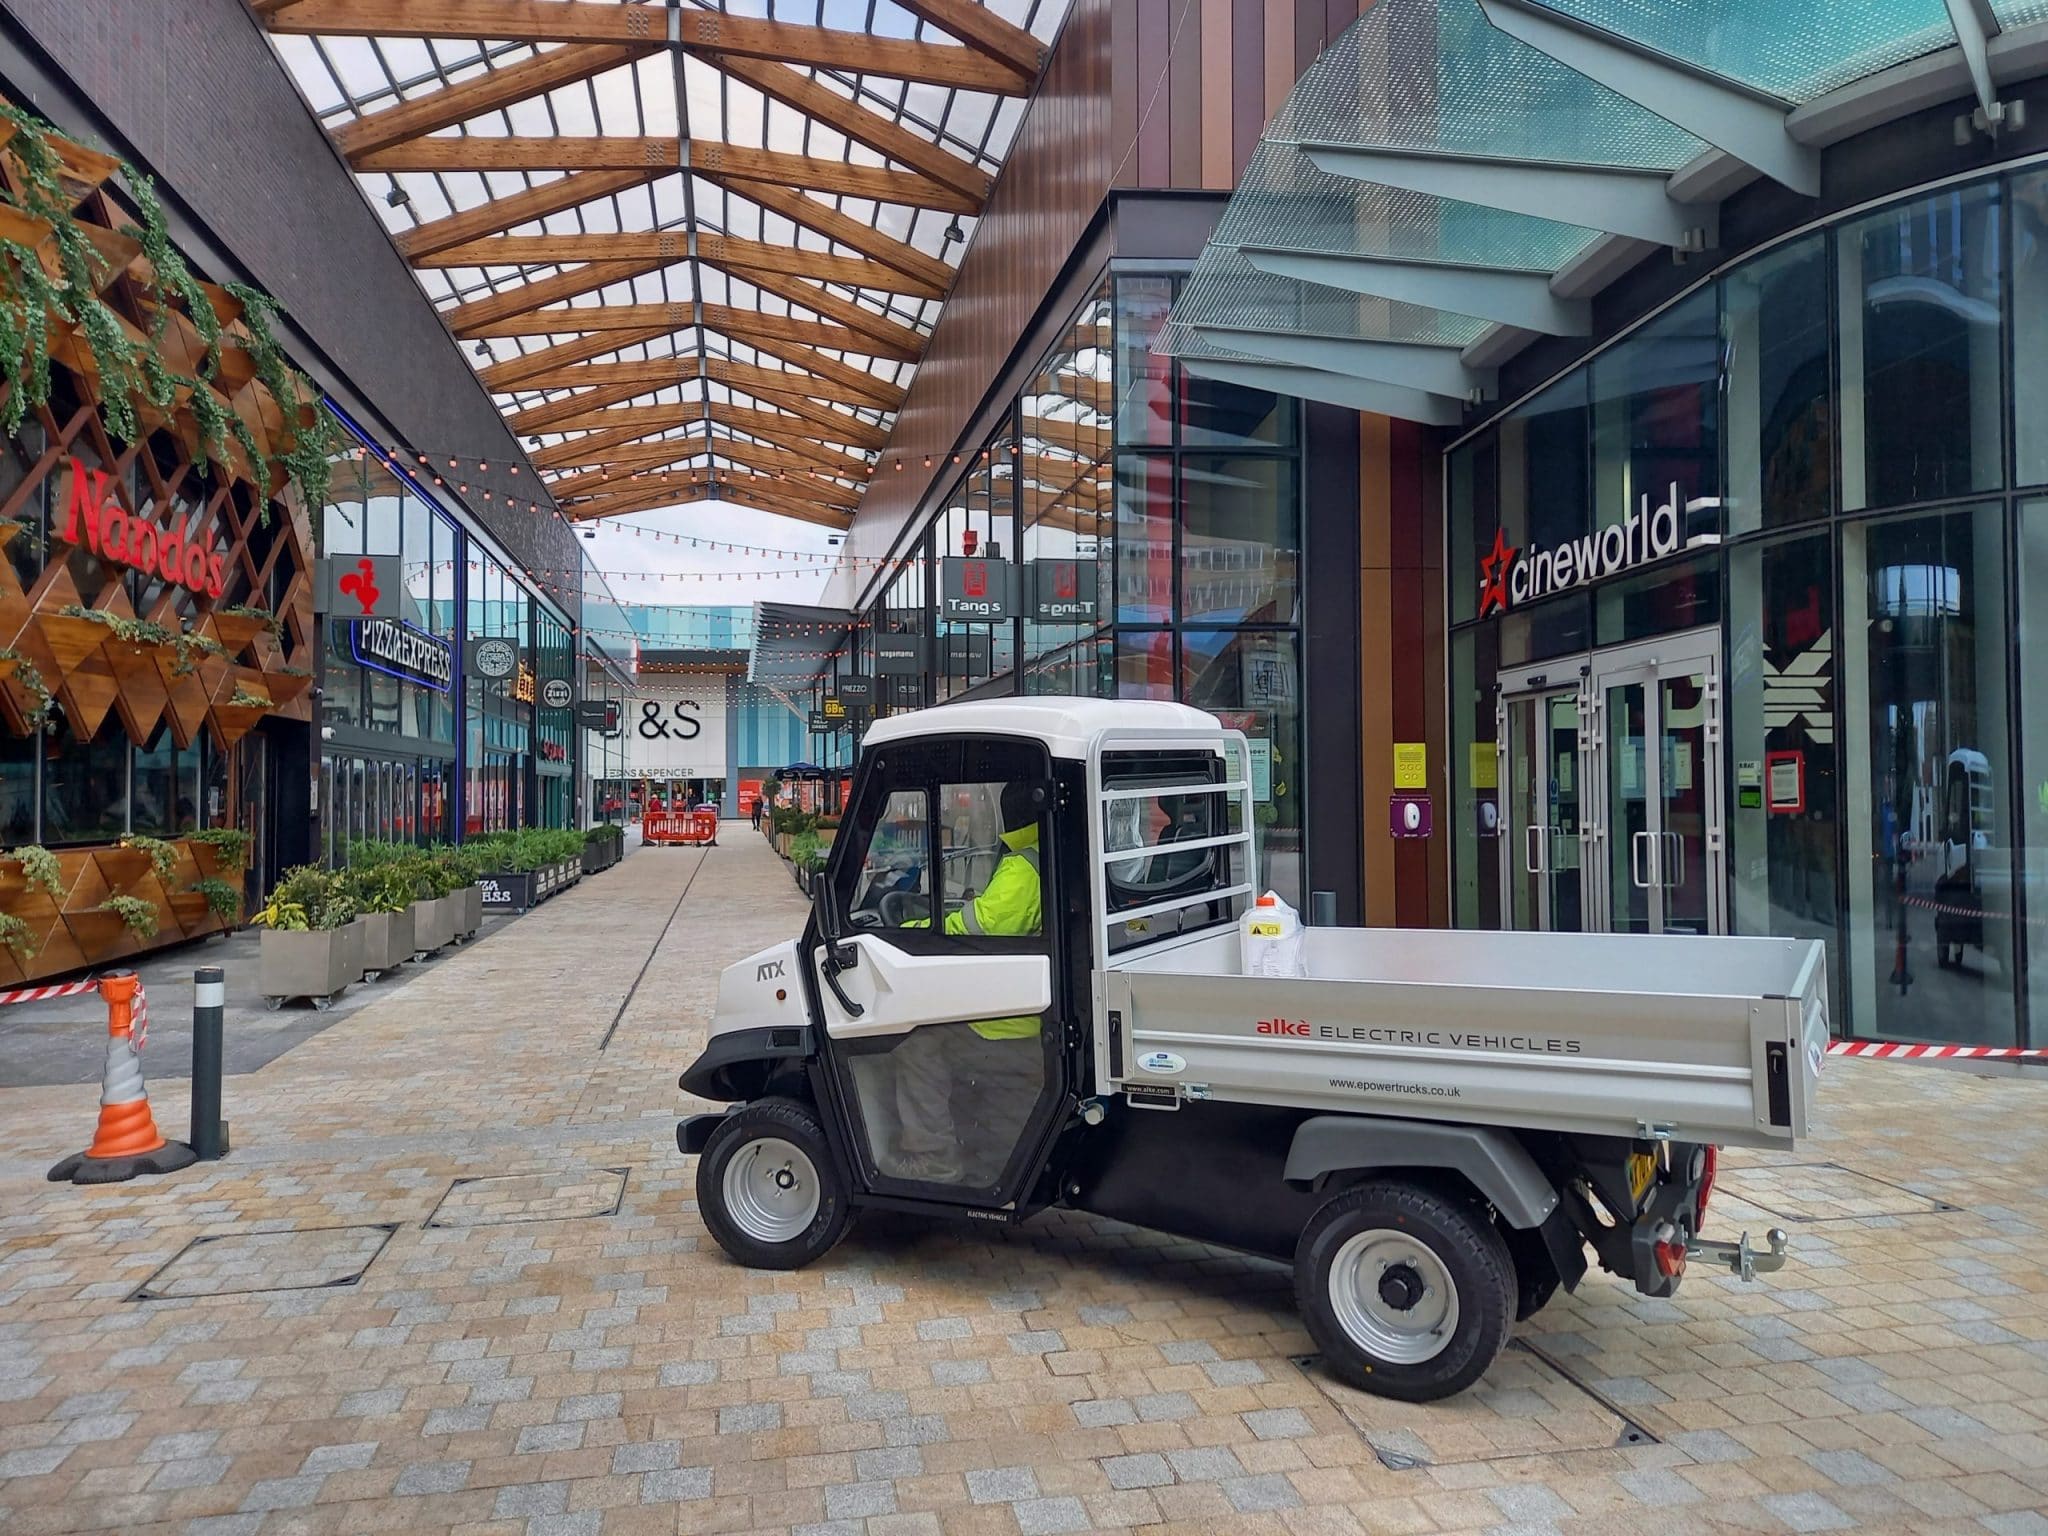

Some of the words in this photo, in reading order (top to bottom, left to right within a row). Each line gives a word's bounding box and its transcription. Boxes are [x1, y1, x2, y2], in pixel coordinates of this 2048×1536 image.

[63, 456, 225, 599] Nando's
[1511, 481, 1677, 601] cineworld
[361, 619, 450, 682] PIZZAEXPRESS
[639, 700, 700, 739] &S
[647, 768, 694, 777] SPENCER
[756, 960, 785, 982] ATX
[1256, 1018, 1311, 1036] alkè
[1320, 1025, 1440, 1045] ELECTRIC
[1450, 1033, 1581, 1053] VEHICLES
[1329, 1077, 1461, 1098] www.epowertrucks.co.uk
